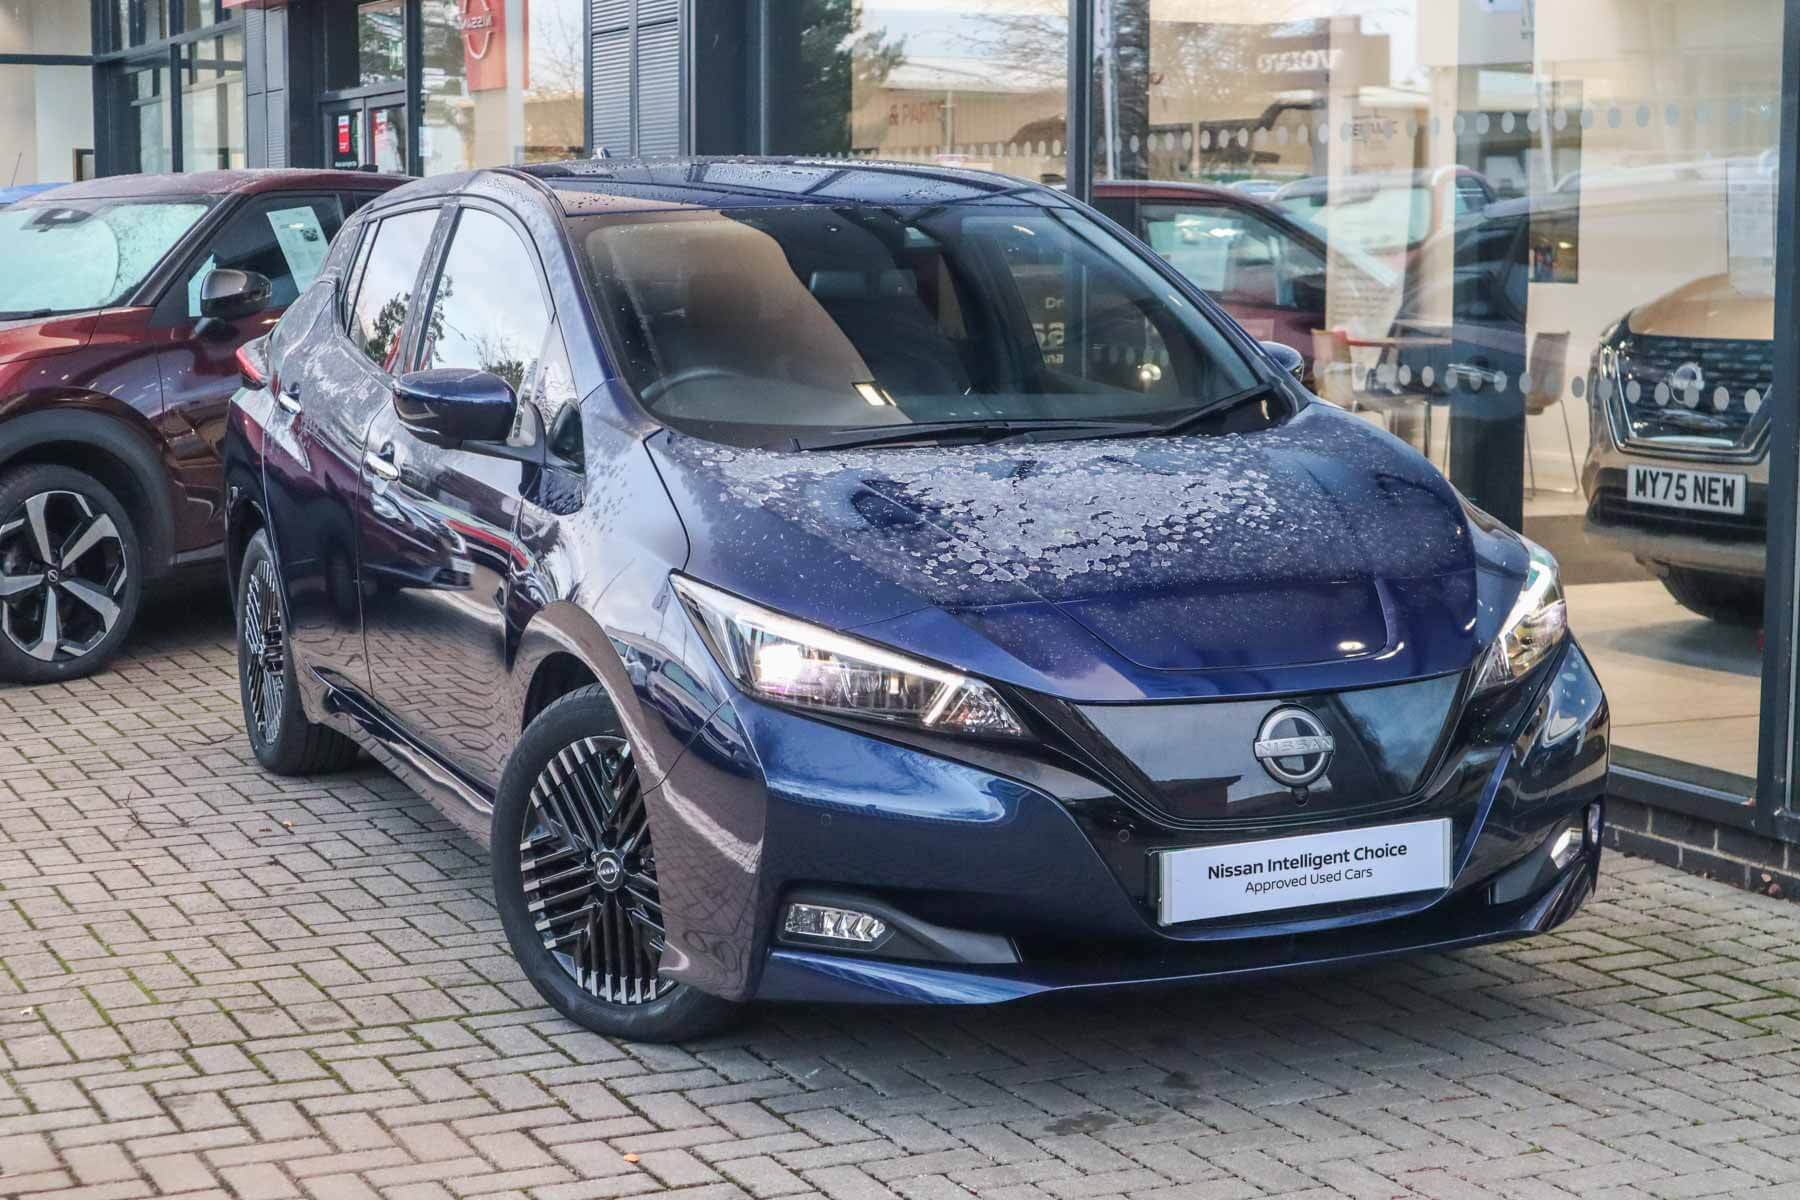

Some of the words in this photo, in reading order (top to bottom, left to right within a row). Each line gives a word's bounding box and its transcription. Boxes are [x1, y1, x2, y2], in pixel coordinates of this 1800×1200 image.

[1635, 468, 1687, 501] MY75
[1693, 476, 1735, 507] NEW
[1258, 738, 1332, 755] NISSAN
[1208, 861, 1264, 880] Nissan
[1268, 848, 1350, 873] Intelligent
[1354, 843, 1407, 861] Choice
[1245, 874, 1307, 894] Approved
[1311, 870, 1341, 885] Used
[1345, 868, 1373, 880] Cars
